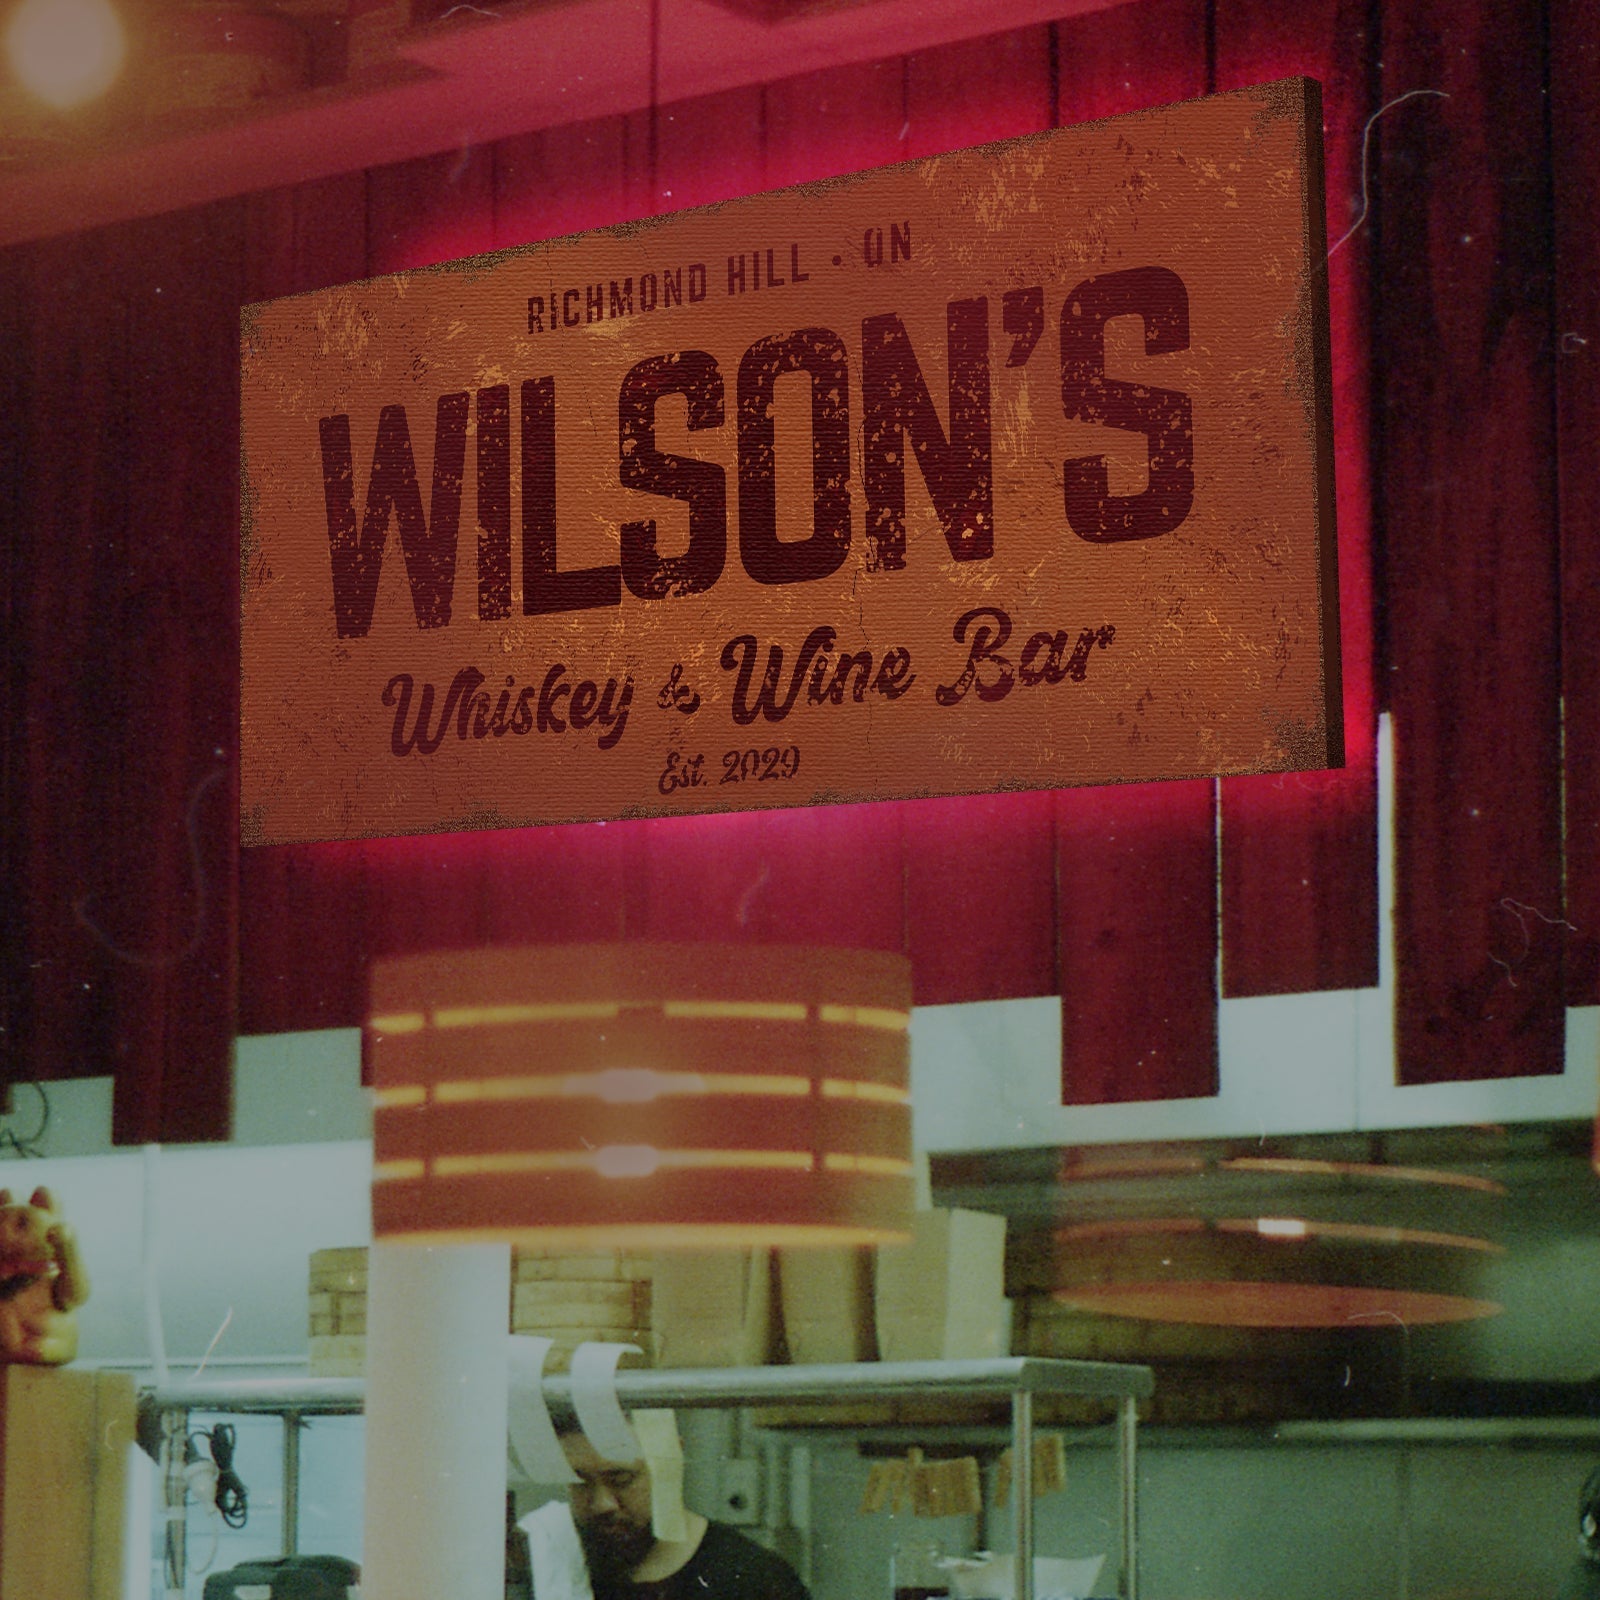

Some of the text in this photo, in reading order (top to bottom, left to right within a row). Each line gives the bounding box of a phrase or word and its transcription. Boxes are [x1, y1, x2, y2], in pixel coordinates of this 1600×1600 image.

[528, 263, 706, 335] RICHMOND
[727, 243, 810, 296] HILL
[863, 221, 911, 267] ON
[381, 607, 1116, 757] Whiskey & Wine Bar
[658, 752, 708, 795] Est.
